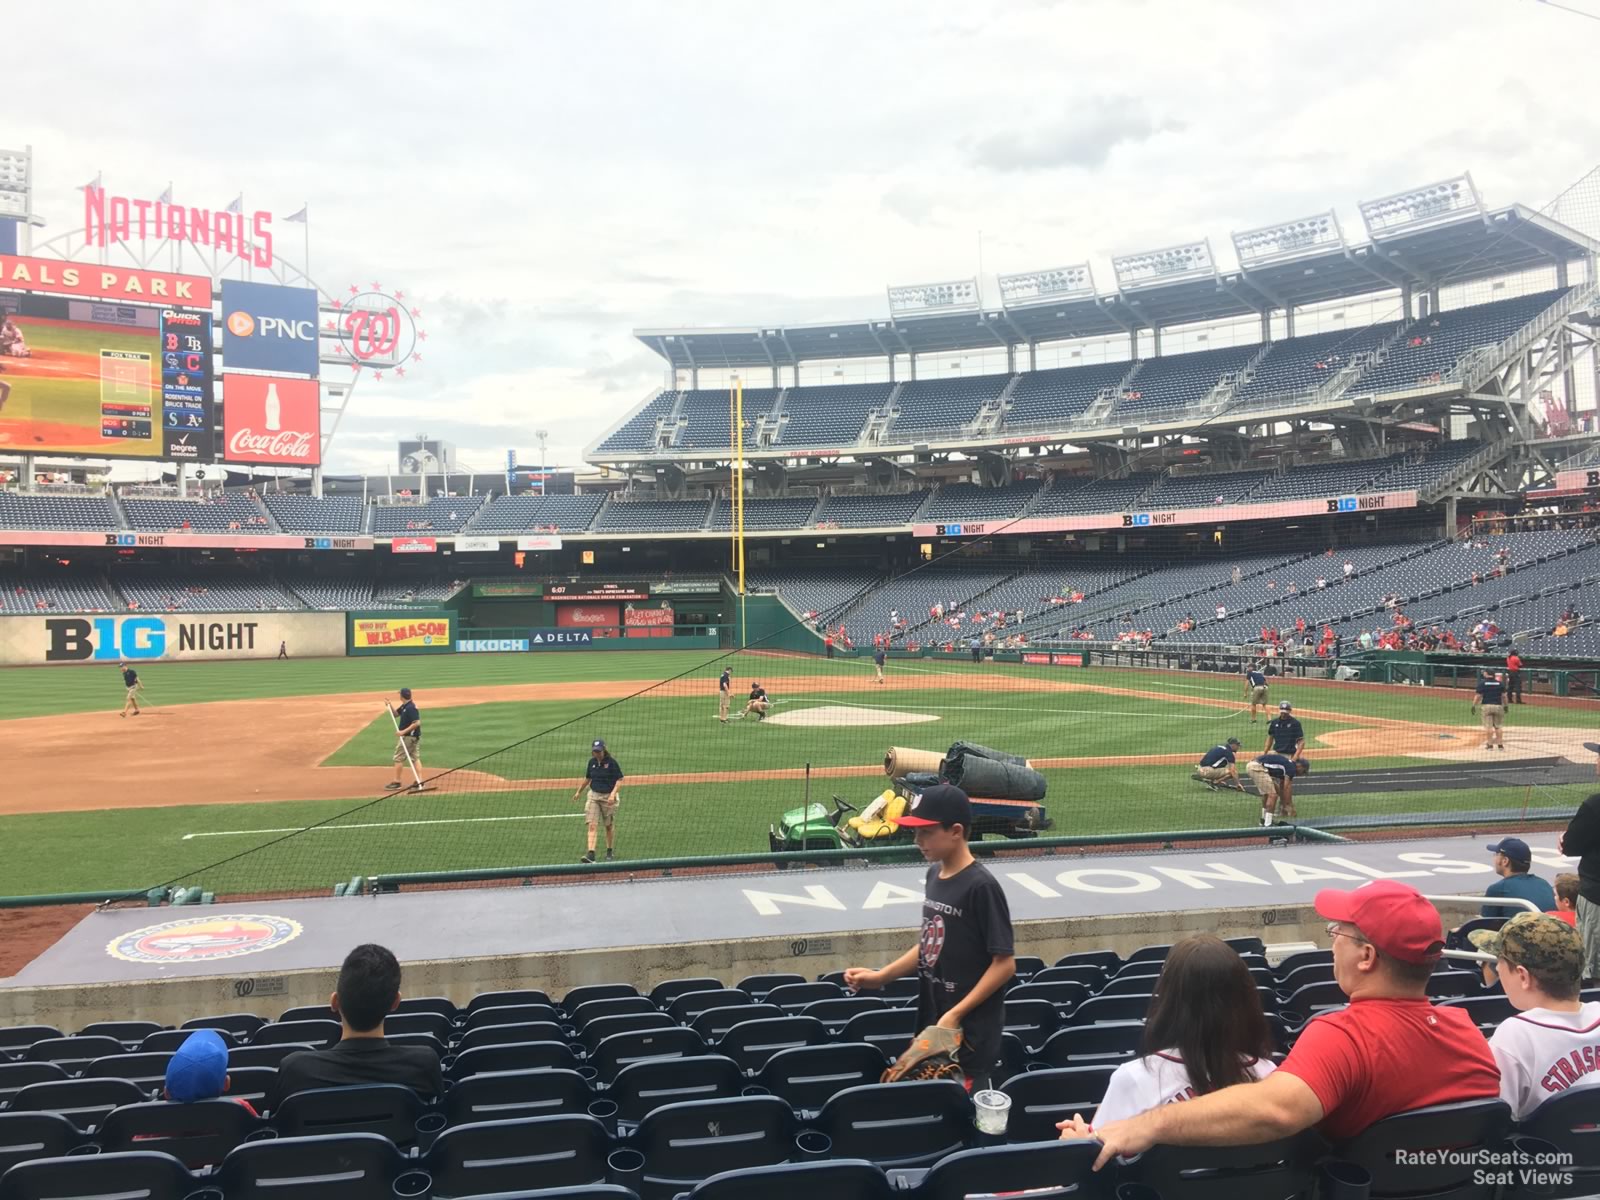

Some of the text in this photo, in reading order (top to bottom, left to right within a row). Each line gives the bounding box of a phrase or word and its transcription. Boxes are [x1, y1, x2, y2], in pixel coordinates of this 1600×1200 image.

[85, 186, 273, 269] NATIONALS
[101, 272, 192, 299] PARK
[163, 310, 201, 320] QUICK
[258, 316, 315, 341] PNC
[345, 307, 402, 360] W
[229, 428, 315, 457] Coca-Cola
[170, 444, 198, 453] Degree
[1359, 496, 1385, 509] NIGHT
[1152, 513, 1176, 524] NIGHT
[963, 524, 985, 534] NIGHT
[138, 535, 165, 545] NIGHT
[333, 539, 356, 548] NIGHT
[551, 586, 566, 594] 6:07
[179, 623, 258, 651] NIGHT
[708, 627, 717, 636] 335
[547, 633, 590, 642] DELTA
[477, 639, 520, 651] KOCH
[742, 852, 1494, 916] NAIONALS
